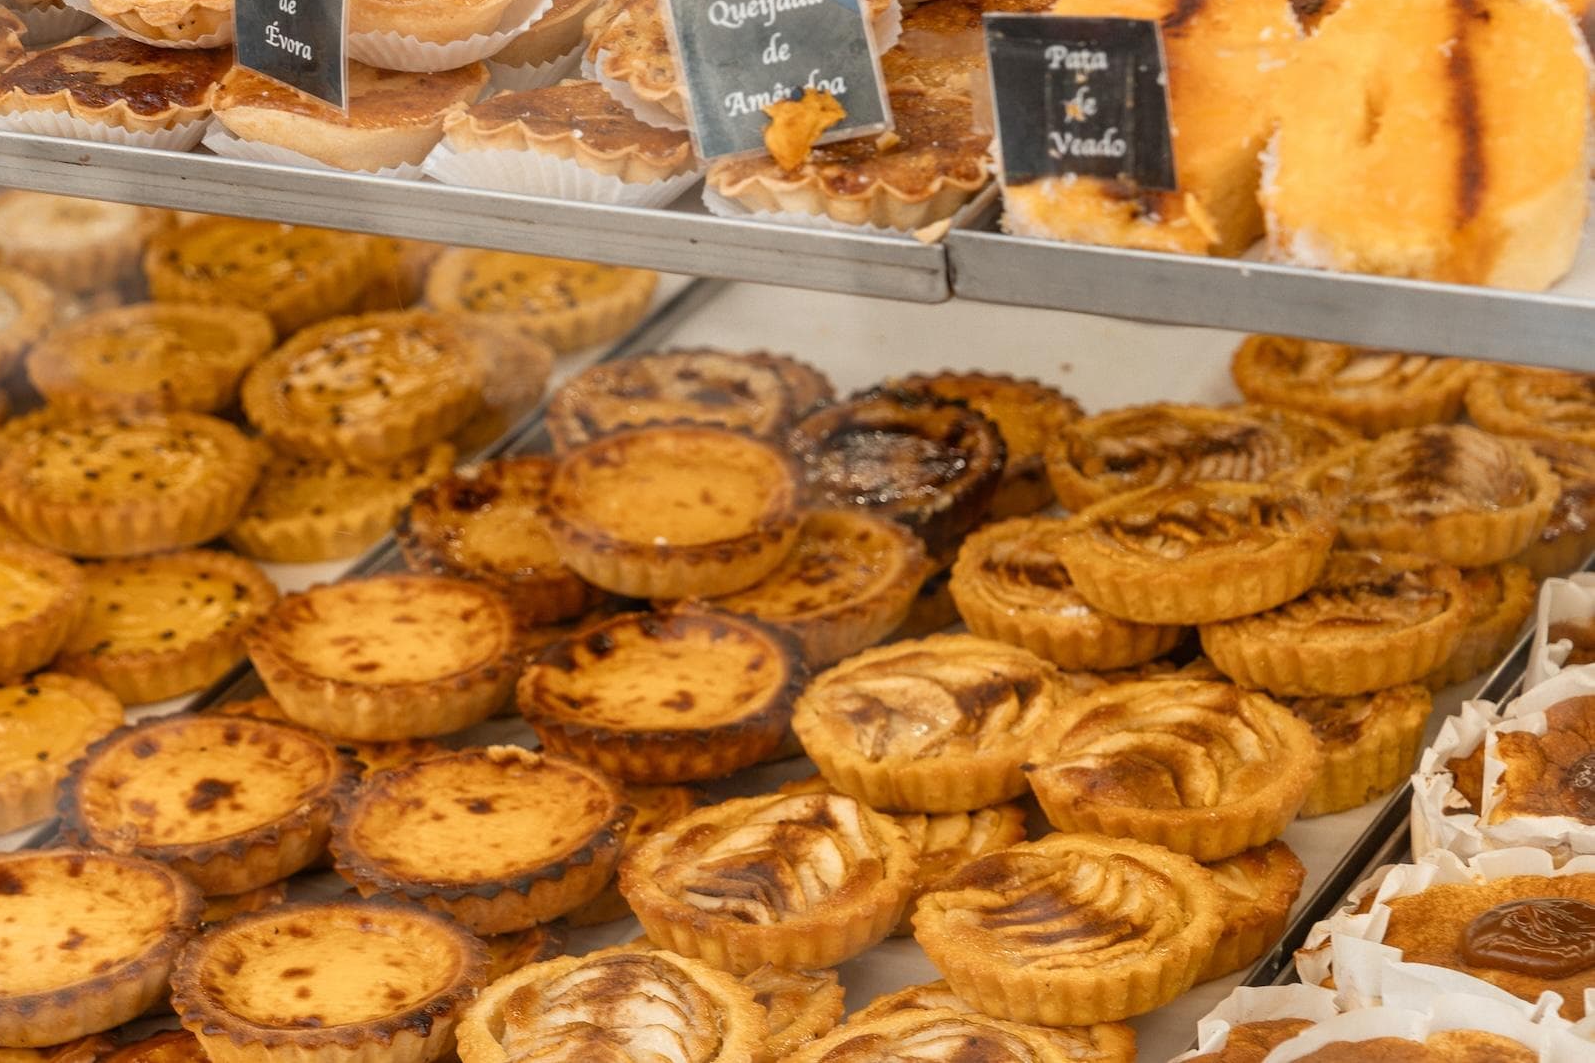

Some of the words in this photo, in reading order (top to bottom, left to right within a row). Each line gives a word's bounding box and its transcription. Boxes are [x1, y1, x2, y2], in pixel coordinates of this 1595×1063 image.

[265, 21, 313, 61] Évora
[762, 32, 791, 65] de
[1044, 44, 1109, 71] Pata
[1048, 127, 1127, 159] Veado
